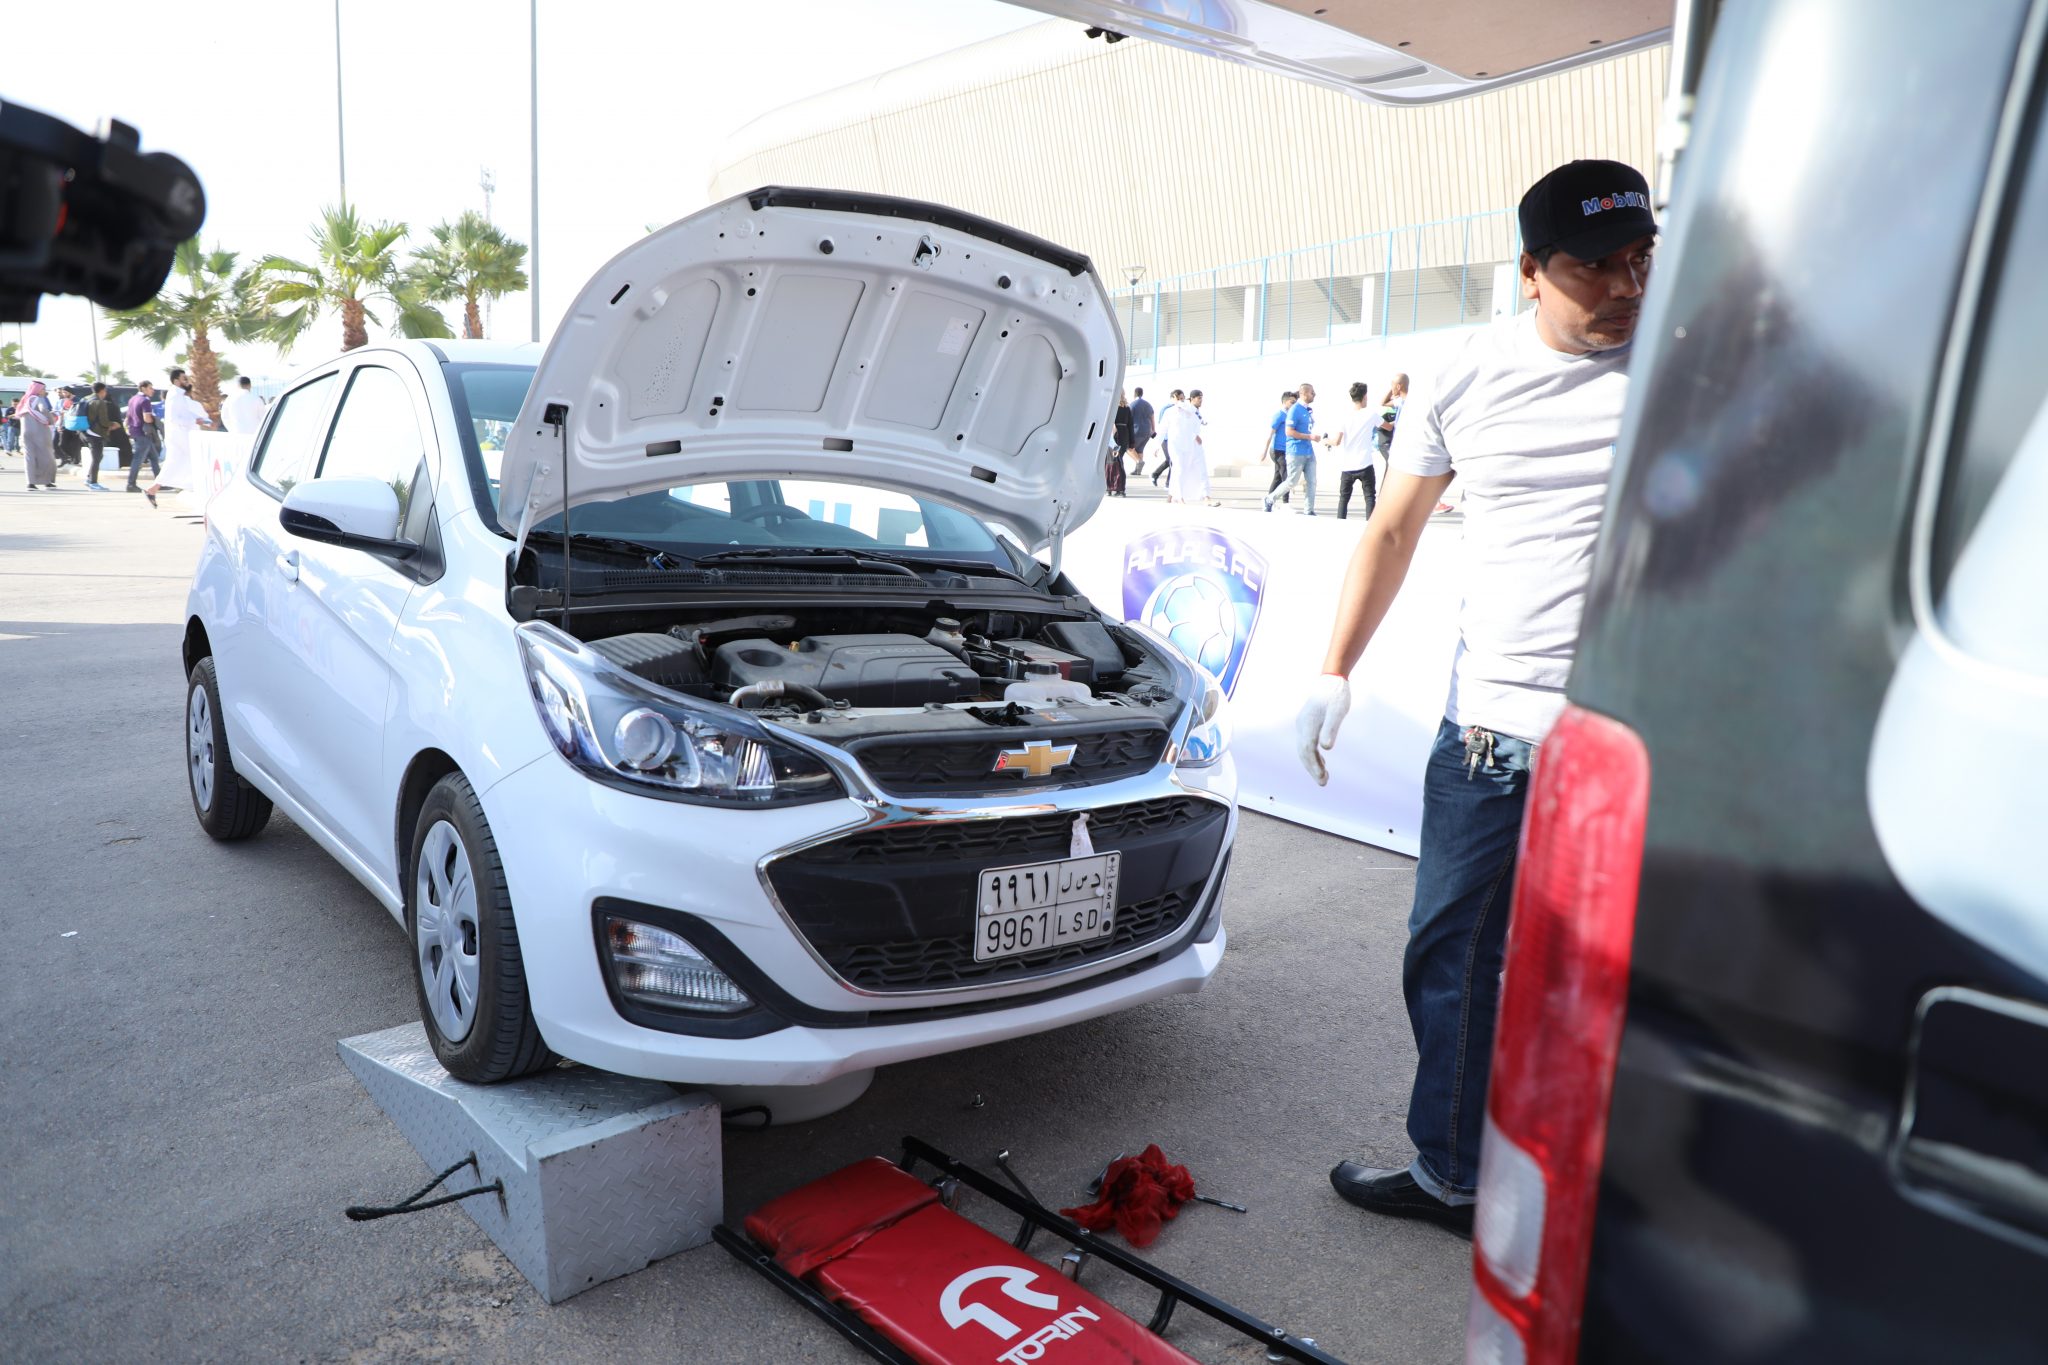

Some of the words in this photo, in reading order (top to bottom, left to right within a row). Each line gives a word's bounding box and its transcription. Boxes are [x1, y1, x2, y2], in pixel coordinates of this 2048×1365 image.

[1582, 192, 1636, 216] Mobil
[987, 912, 1048, 953] 9961
[1057, 909, 1098, 936] LSD
[996, 1305, 1101, 1365] TORIN
